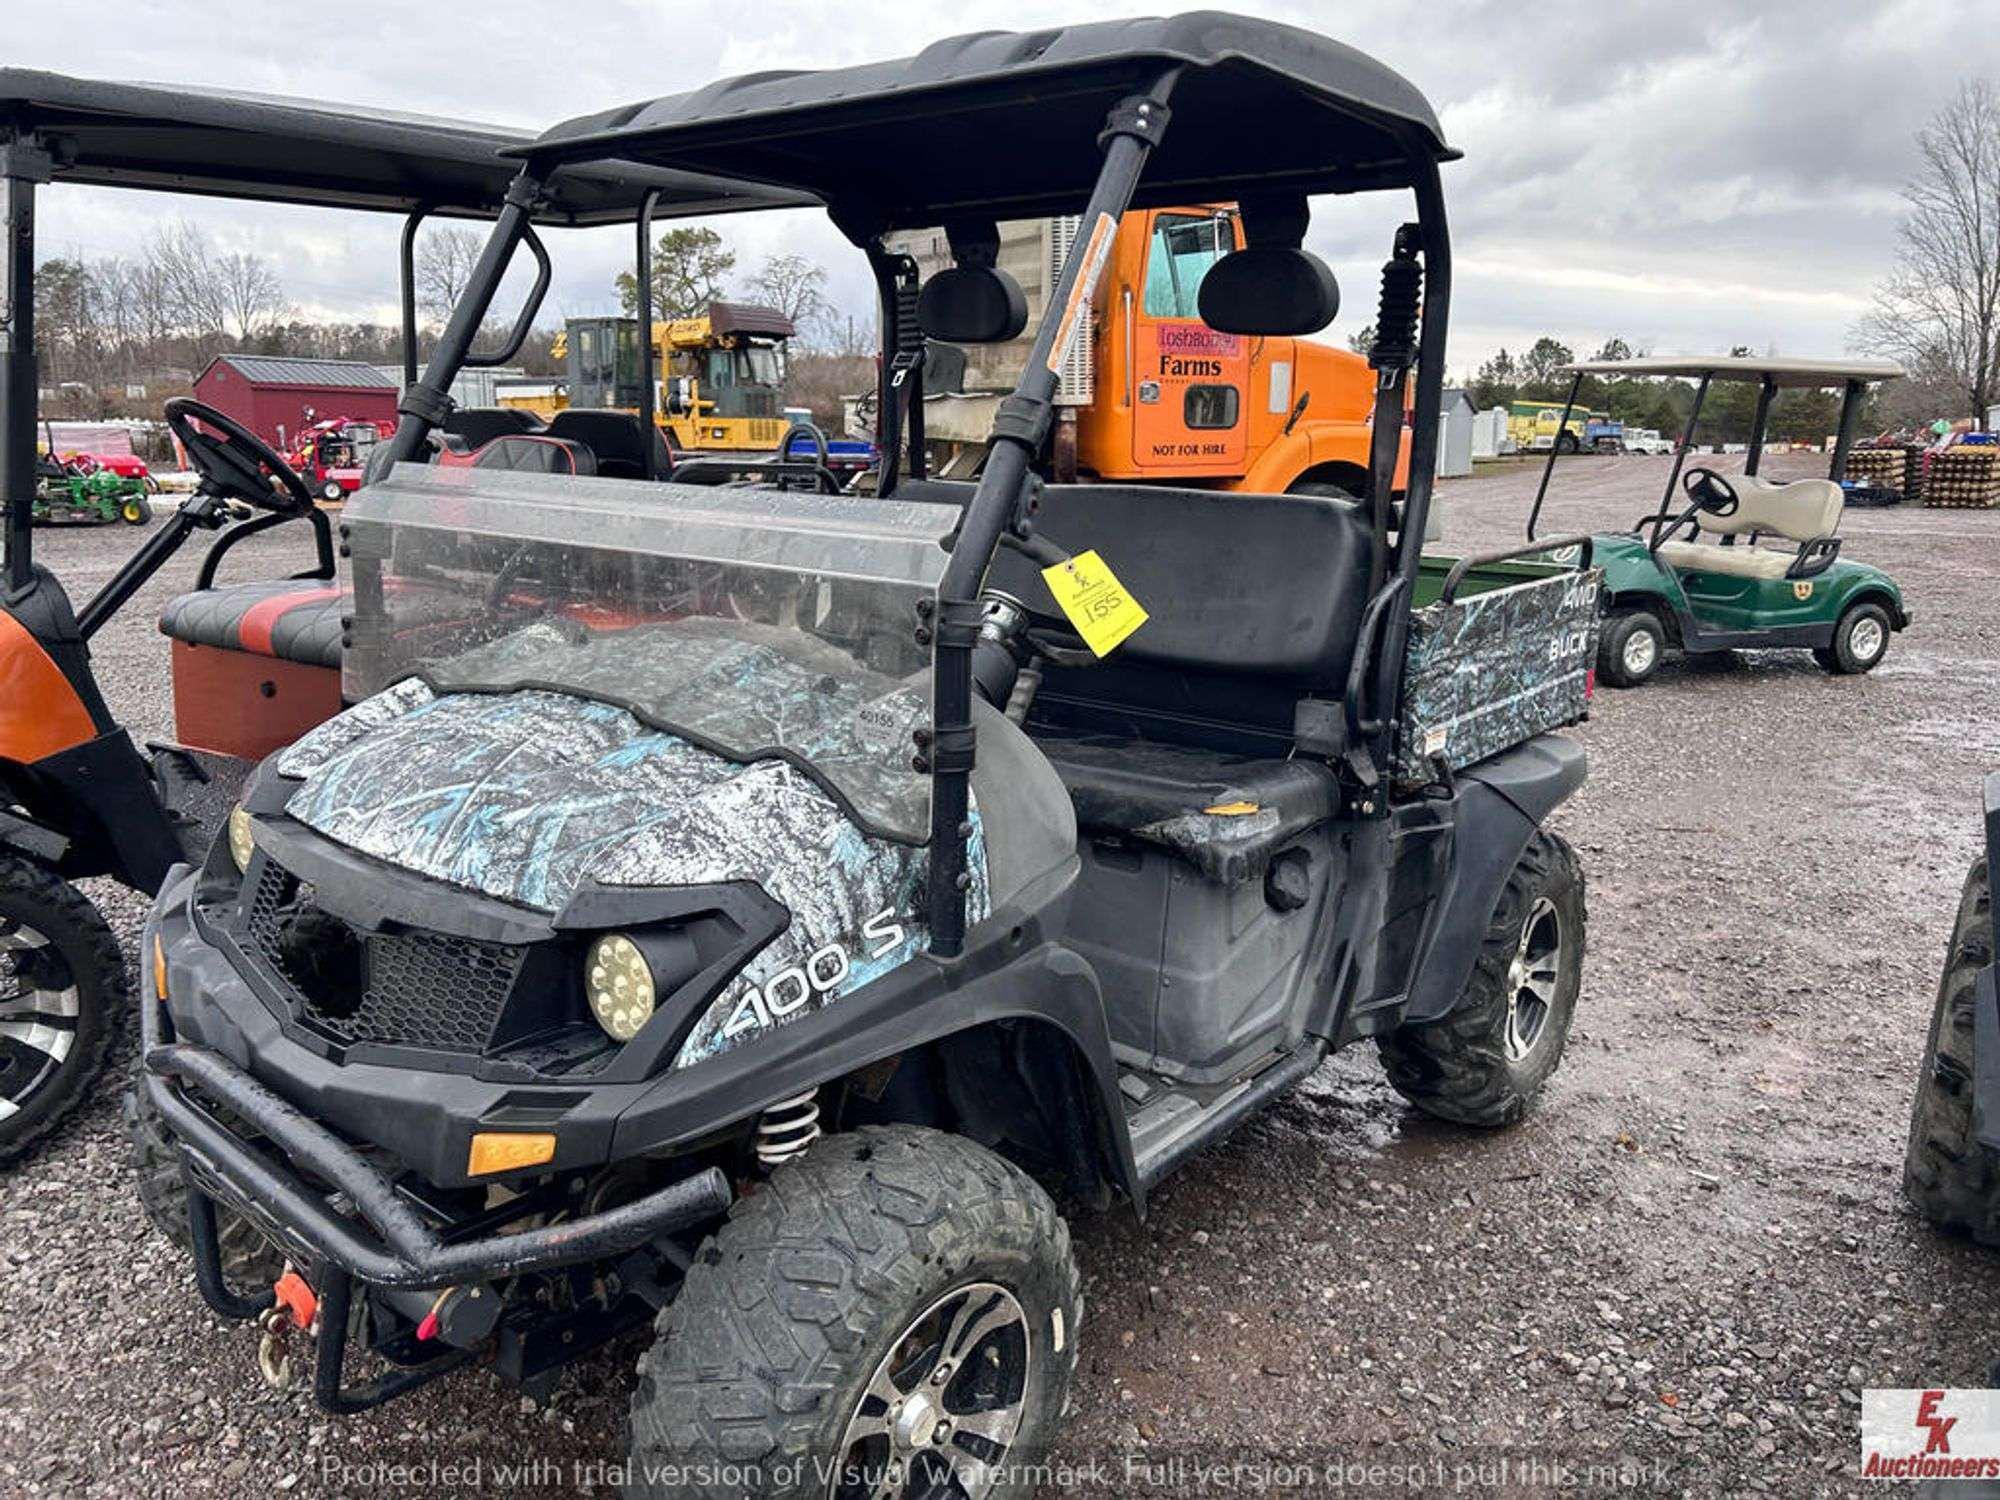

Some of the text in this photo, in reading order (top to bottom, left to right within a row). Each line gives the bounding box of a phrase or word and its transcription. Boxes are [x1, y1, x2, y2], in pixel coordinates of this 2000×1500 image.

[1160, 355, 1222, 376] Farms
[1152, 443, 1227, 457] NOT FOR HIRE
[1084, 590, 1122, 623] 155
[1549, 630, 1588, 662] BUCK
[723, 906, 905, 1038] 400 S
